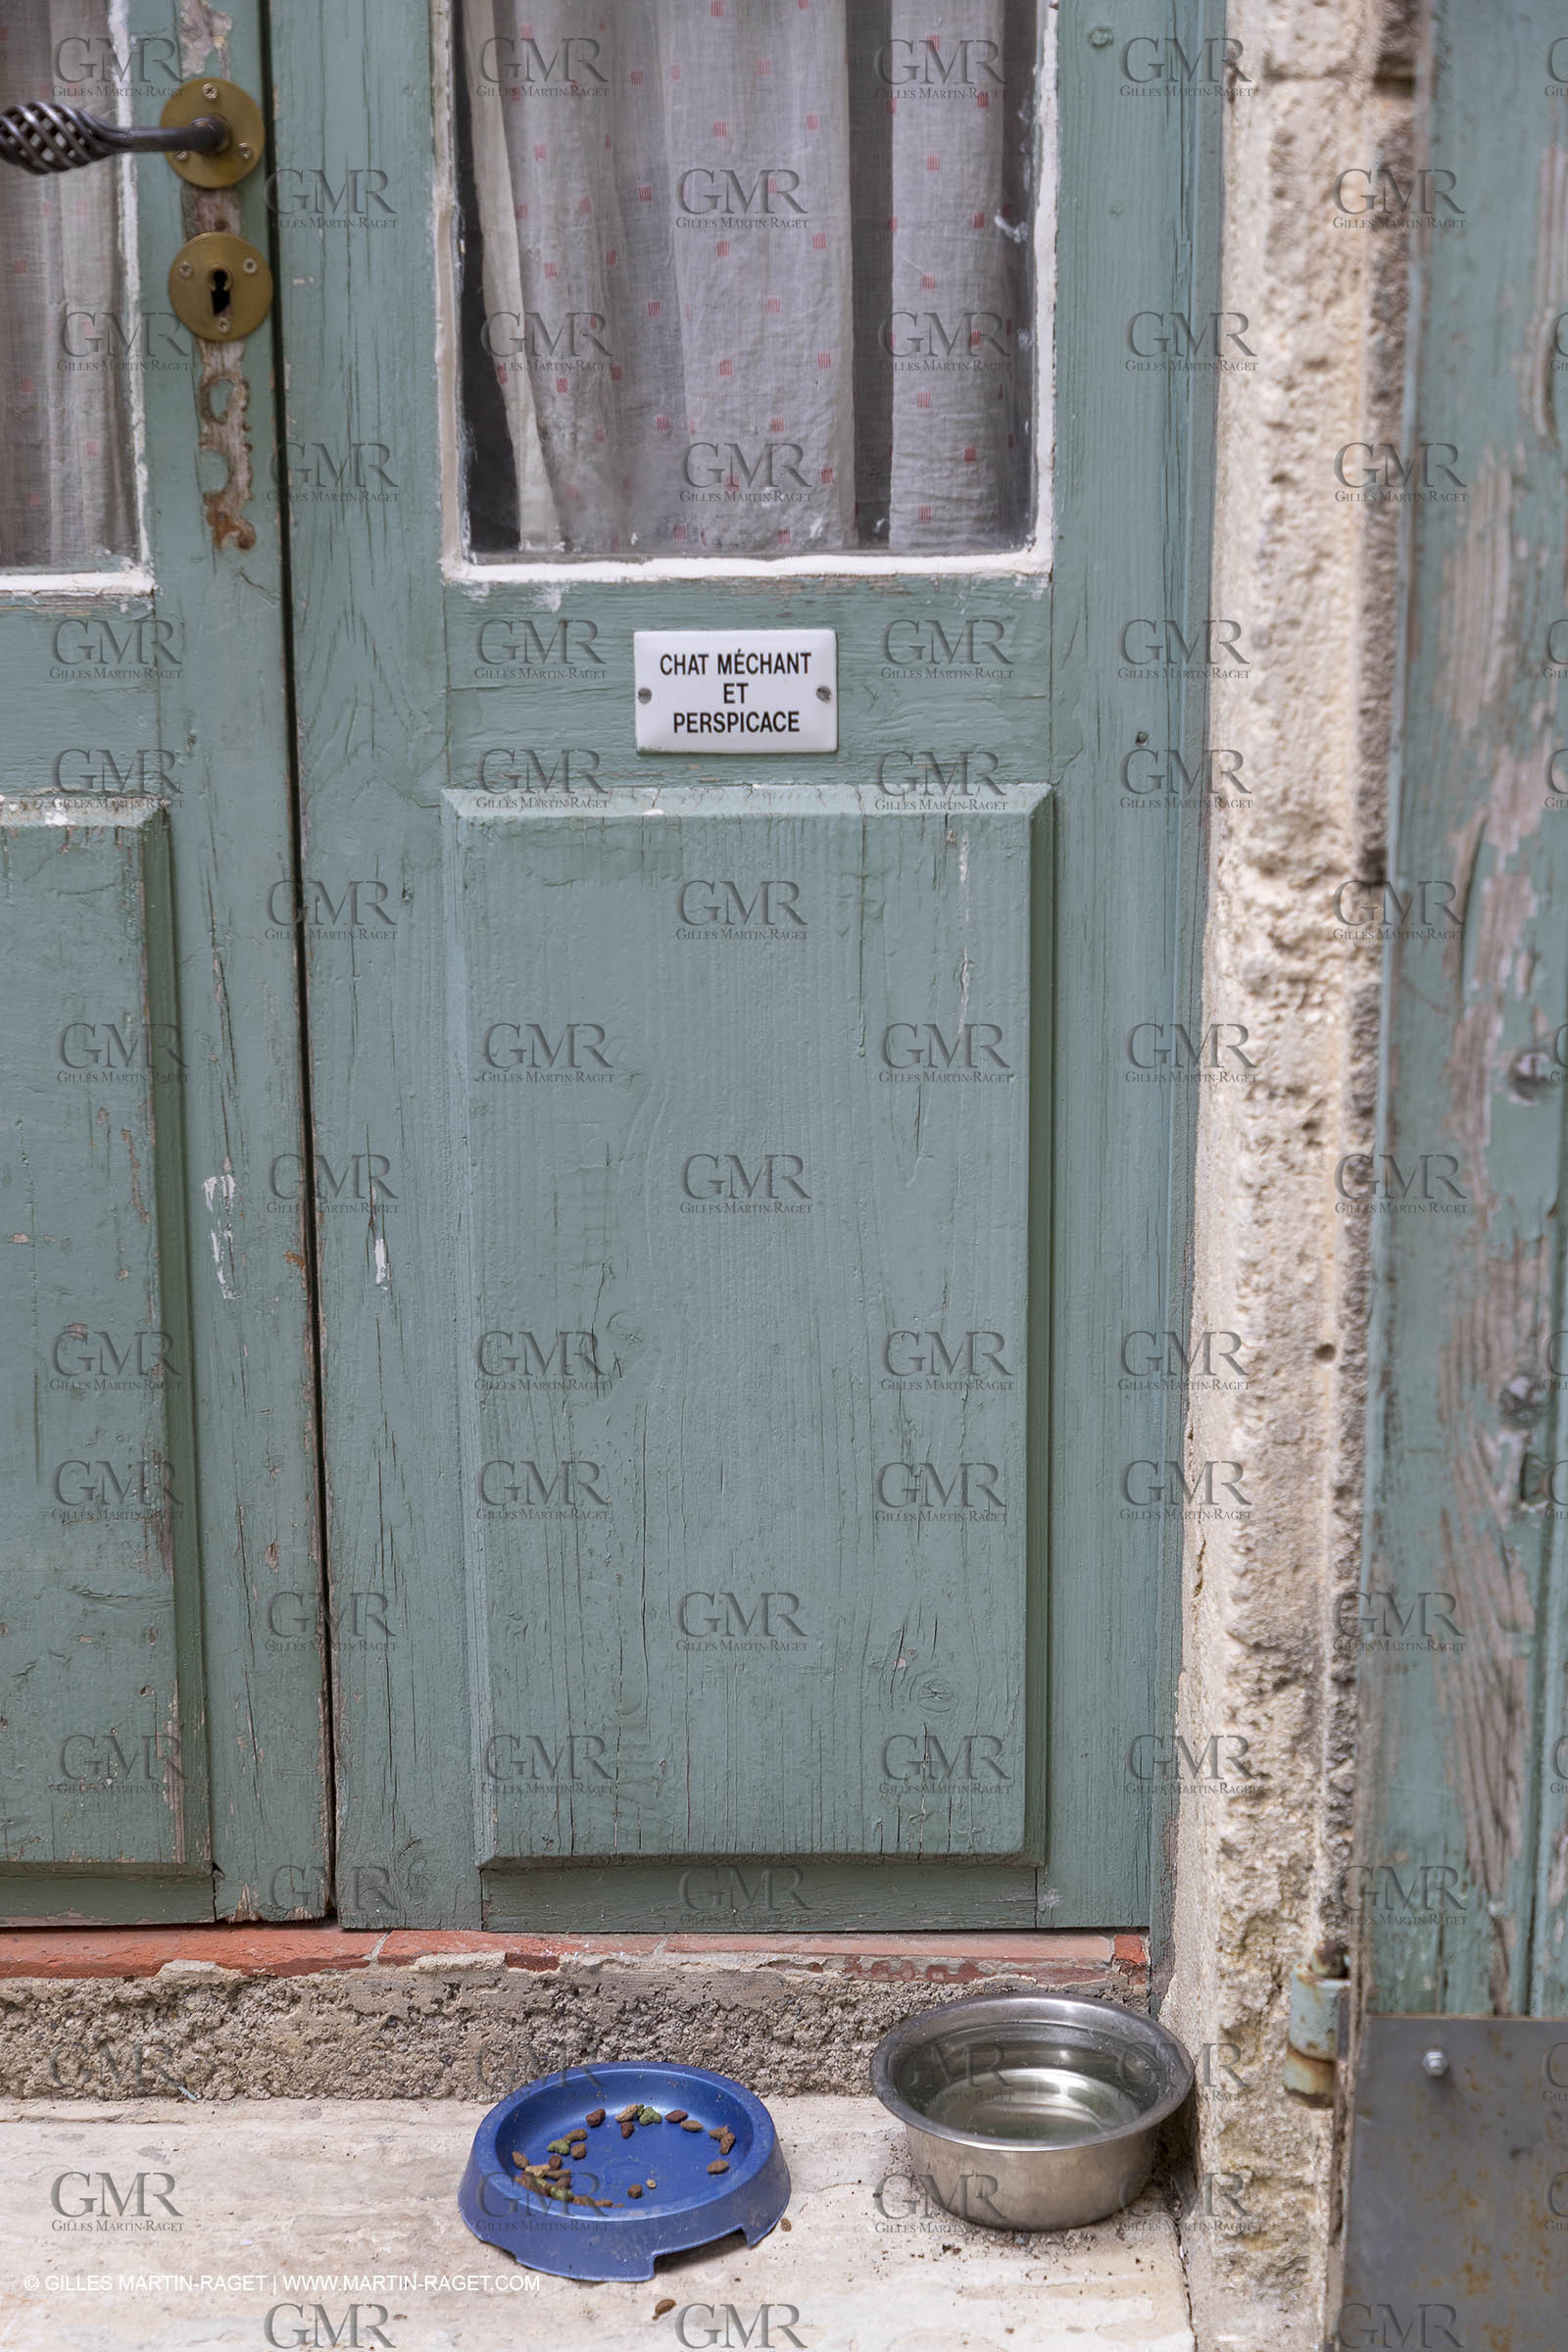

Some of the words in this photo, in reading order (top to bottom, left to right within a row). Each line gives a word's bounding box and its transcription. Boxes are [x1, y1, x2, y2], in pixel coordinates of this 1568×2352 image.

[660, 654, 709, 675] CHAT
[717, 648, 811, 674] MÉCHANT
[723, 682, 749, 704] ET
[673, 711, 800, 733] PERSPICACE
